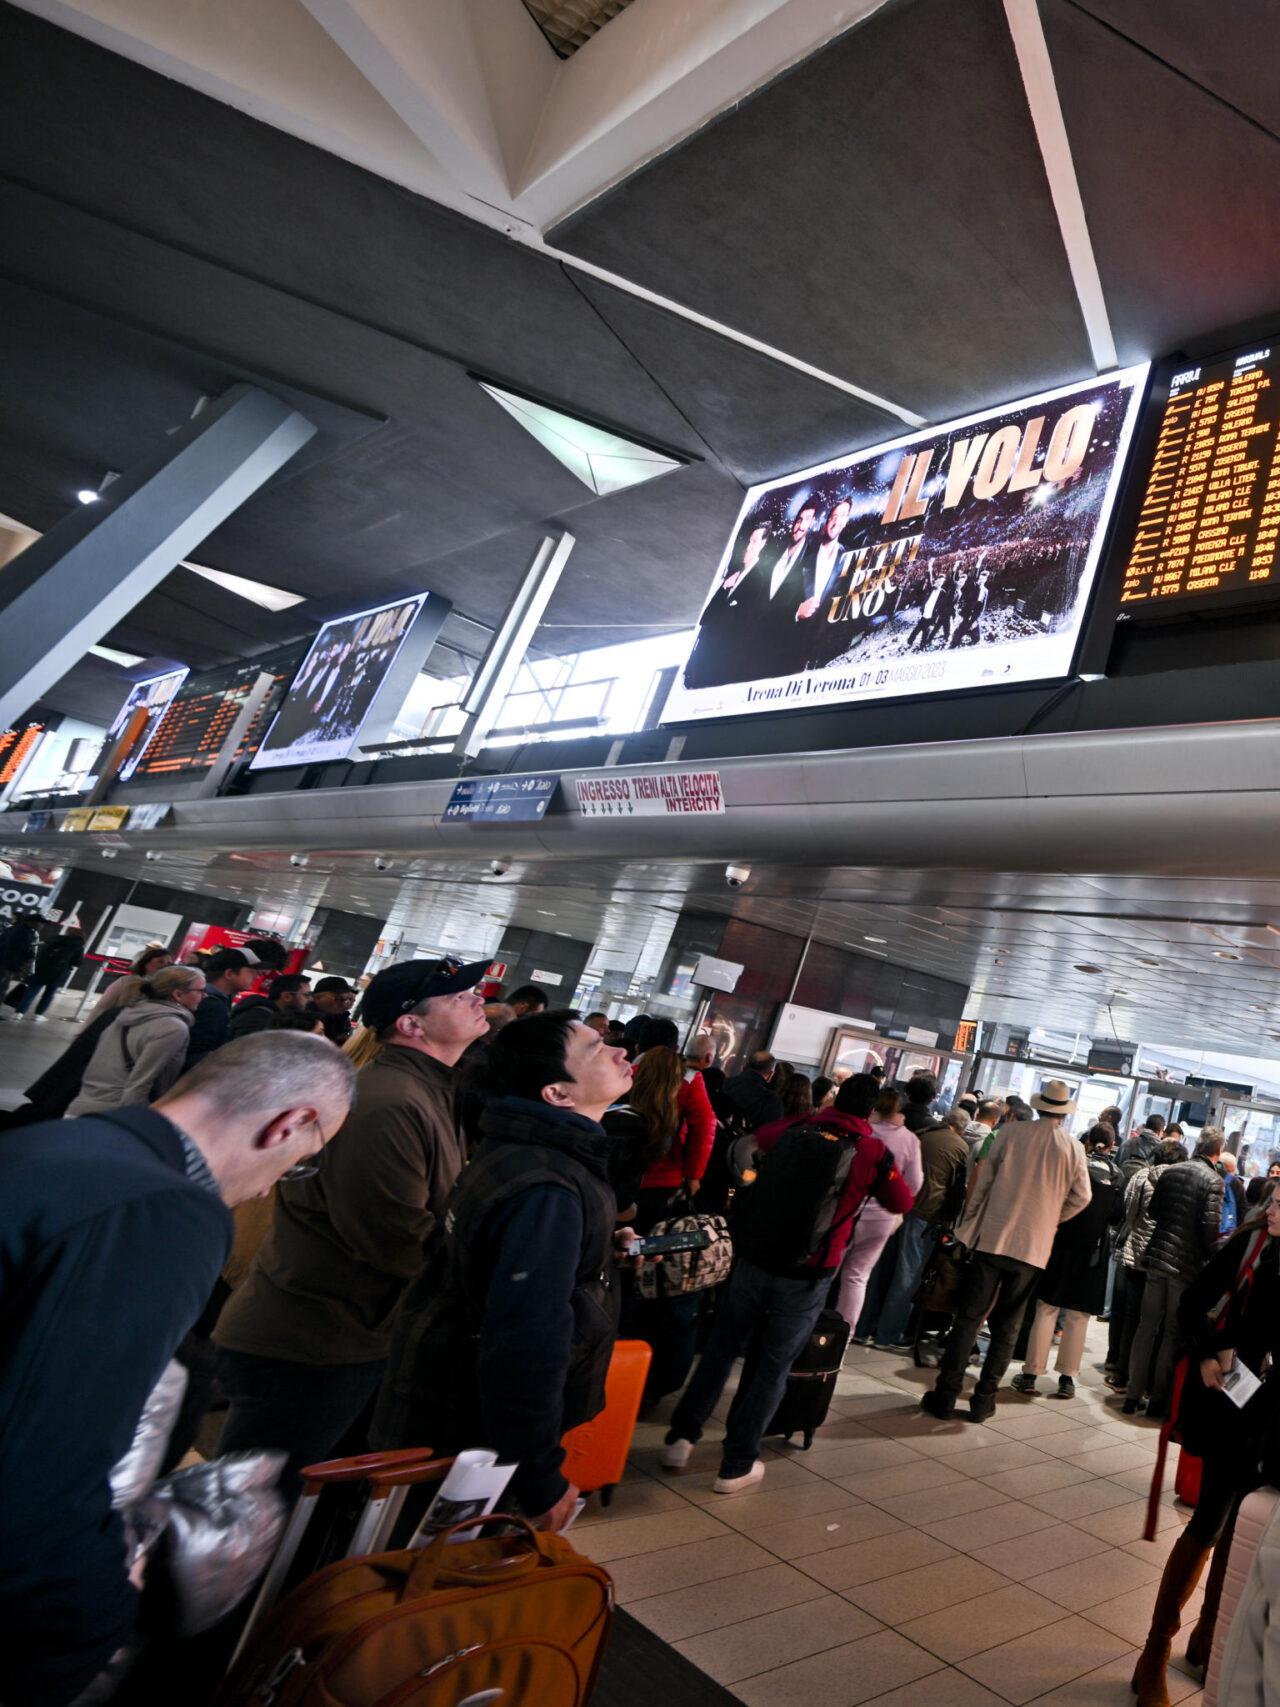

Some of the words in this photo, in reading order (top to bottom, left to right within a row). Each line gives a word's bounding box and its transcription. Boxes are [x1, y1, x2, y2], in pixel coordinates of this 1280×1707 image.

[881, 449, 934, 525] IL
[943, 403, 1098, 509] VOLO
[839, 533, 925, 578] TUTTI
[847, 565, 898, 596] PER
[828, 587, 886, 623] UNO
[747, 685, 783, 702] Arena
[785, 680, 803, 698] Di
[805, 677, 856, 695] Verona
[577, 779, 630, 801] INGRESSO
[632, 777, 659, 799] TRENI
[659, 775, 680, 798] ALTA
[665, 796, 720, 812] INTERCITY
